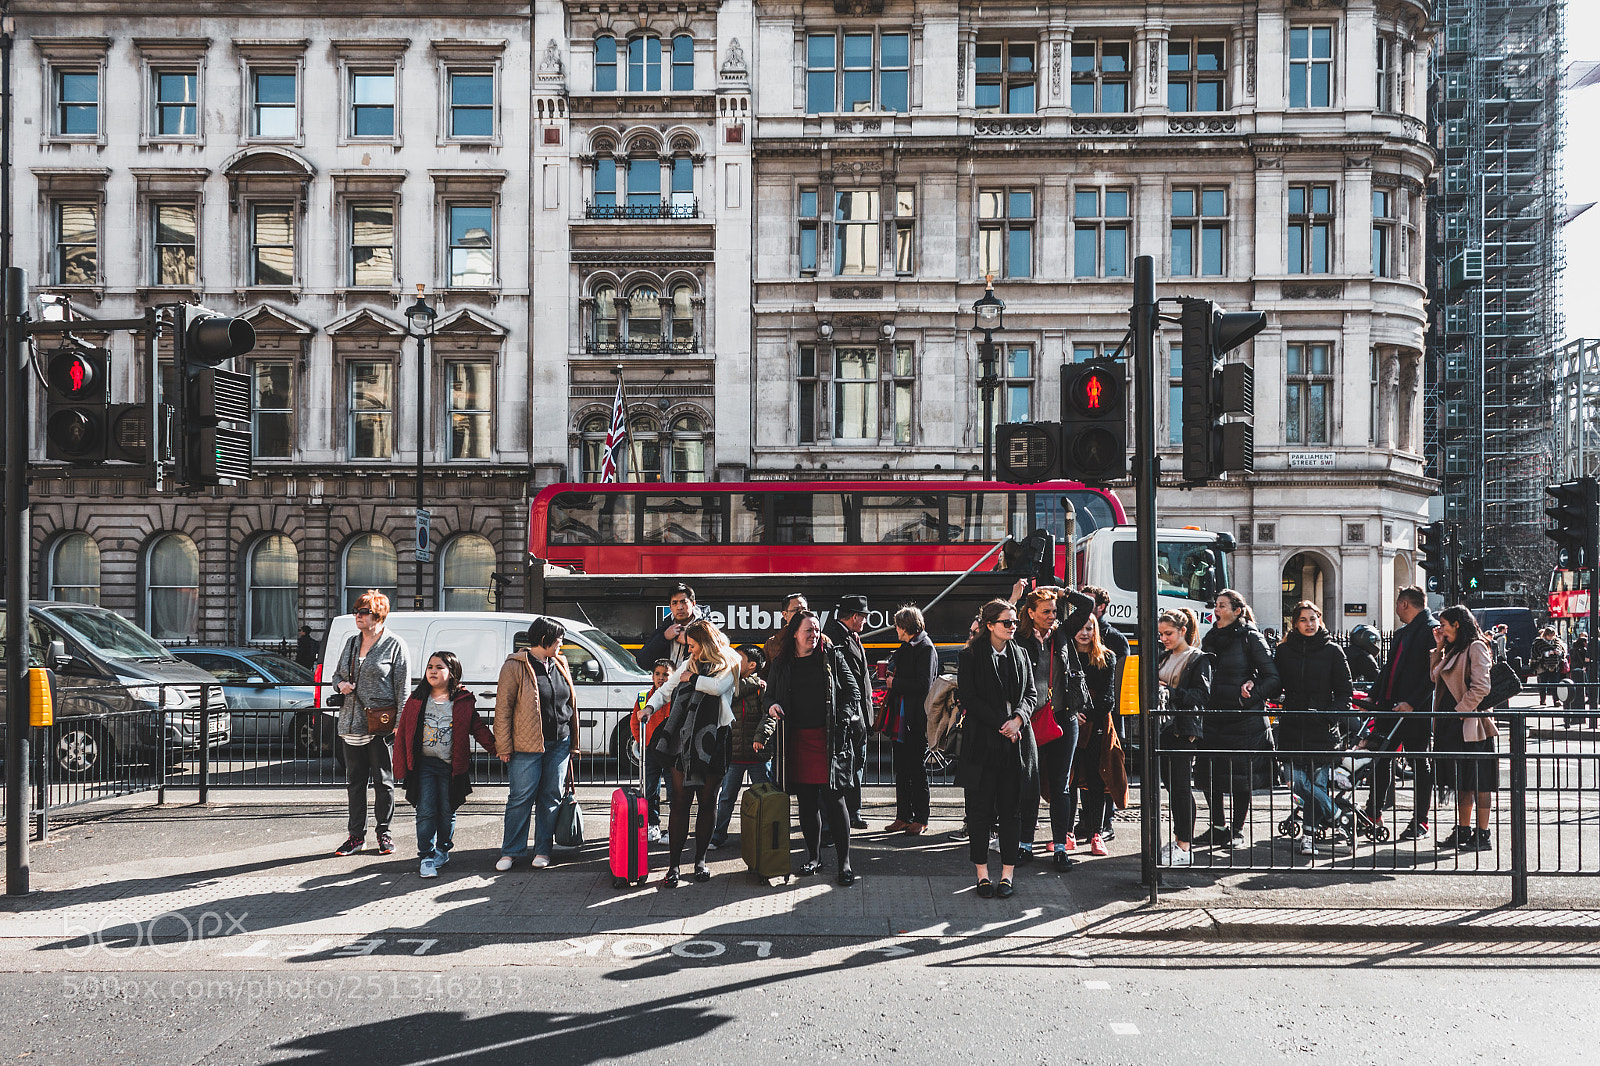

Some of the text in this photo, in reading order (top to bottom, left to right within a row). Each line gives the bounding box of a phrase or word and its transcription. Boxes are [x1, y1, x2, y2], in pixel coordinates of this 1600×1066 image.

[632, 104, 656, 112] 1874
[700, 604, 830, 631] eltbry
[1108, 604, 1132, 618] 020
[222, 938, 439, 956] LEFT
[557, 939, 773, 957] LOOK
